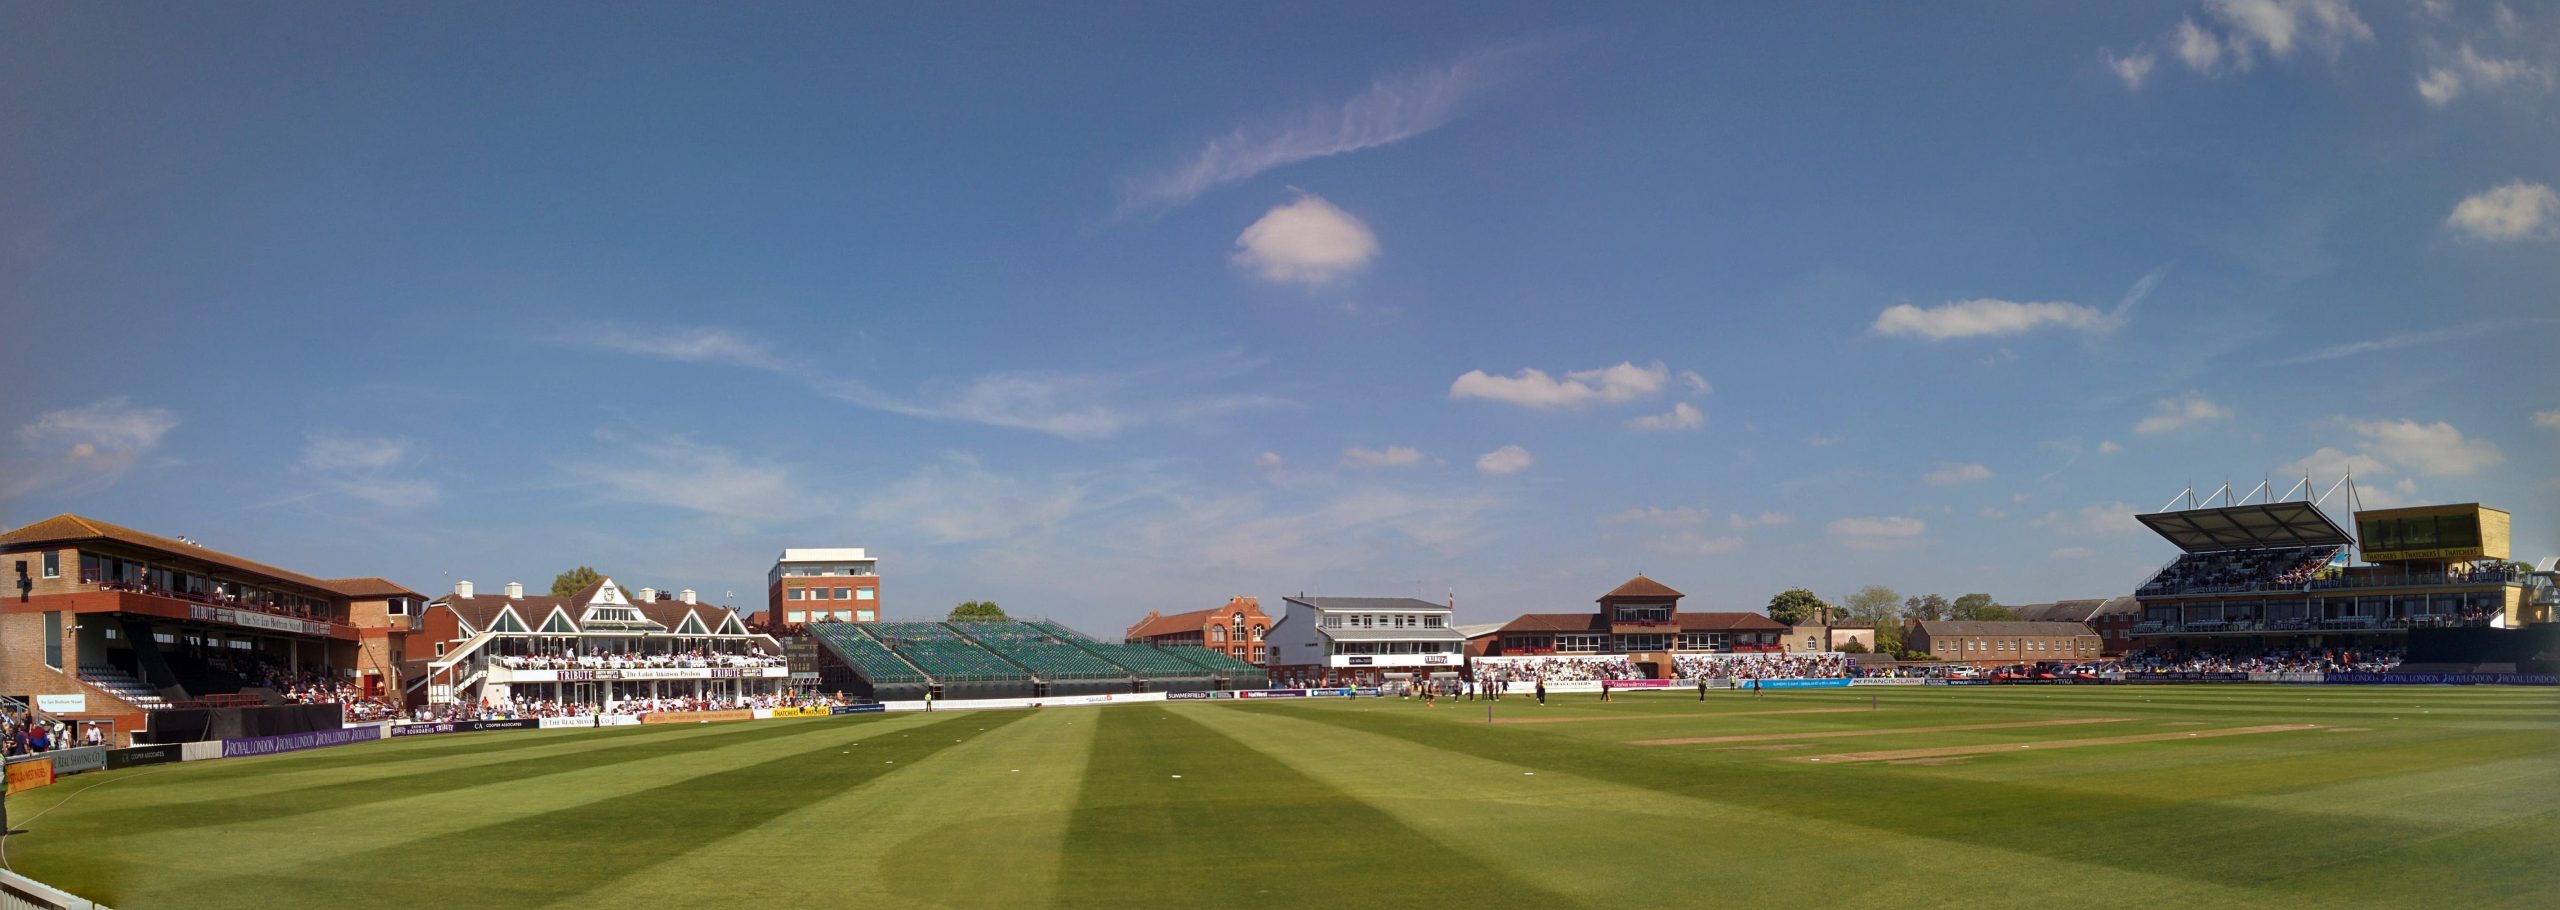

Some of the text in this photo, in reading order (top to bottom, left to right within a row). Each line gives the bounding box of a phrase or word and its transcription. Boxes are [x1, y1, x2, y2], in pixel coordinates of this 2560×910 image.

[2366, 552, 2398, 561] THATCHERS
[2405, 550, 2436, 559] THATCHERS
[2444, 548, 2478, 557] THATCHERS
[190, 604, 216, 621] TRIBUTE
[242, 613, 251, 625] The
[560, 670, 593, 680] TRIBUTE
[713, 668, 741, 678] TRIBUTE
[2330, 674, 2349, 682] ROYAL
[2351, 674, 2378, 682] LONDO
[2388, 674, 2439, 683] ROYAL LONDON
[2500, 675, 2556, 684] ROYAL LONDON
[775, 709, 799, 717] THATCHERS
[435, 723, 454, 733] TRIBUTE
[474, 722, 483, 730] CA
[353, 727, 380, 740] ROYAL LONDON
[407, 727, 435, 735] BOUNDARIES
[319, 731, 350, 745] ROYAL LONDON
[229, 738, 274, 755] ROYAL LONDON
[279, 735, 315, 751] ROYAL LONDON
[131, 752, 144, 760] COOPER
